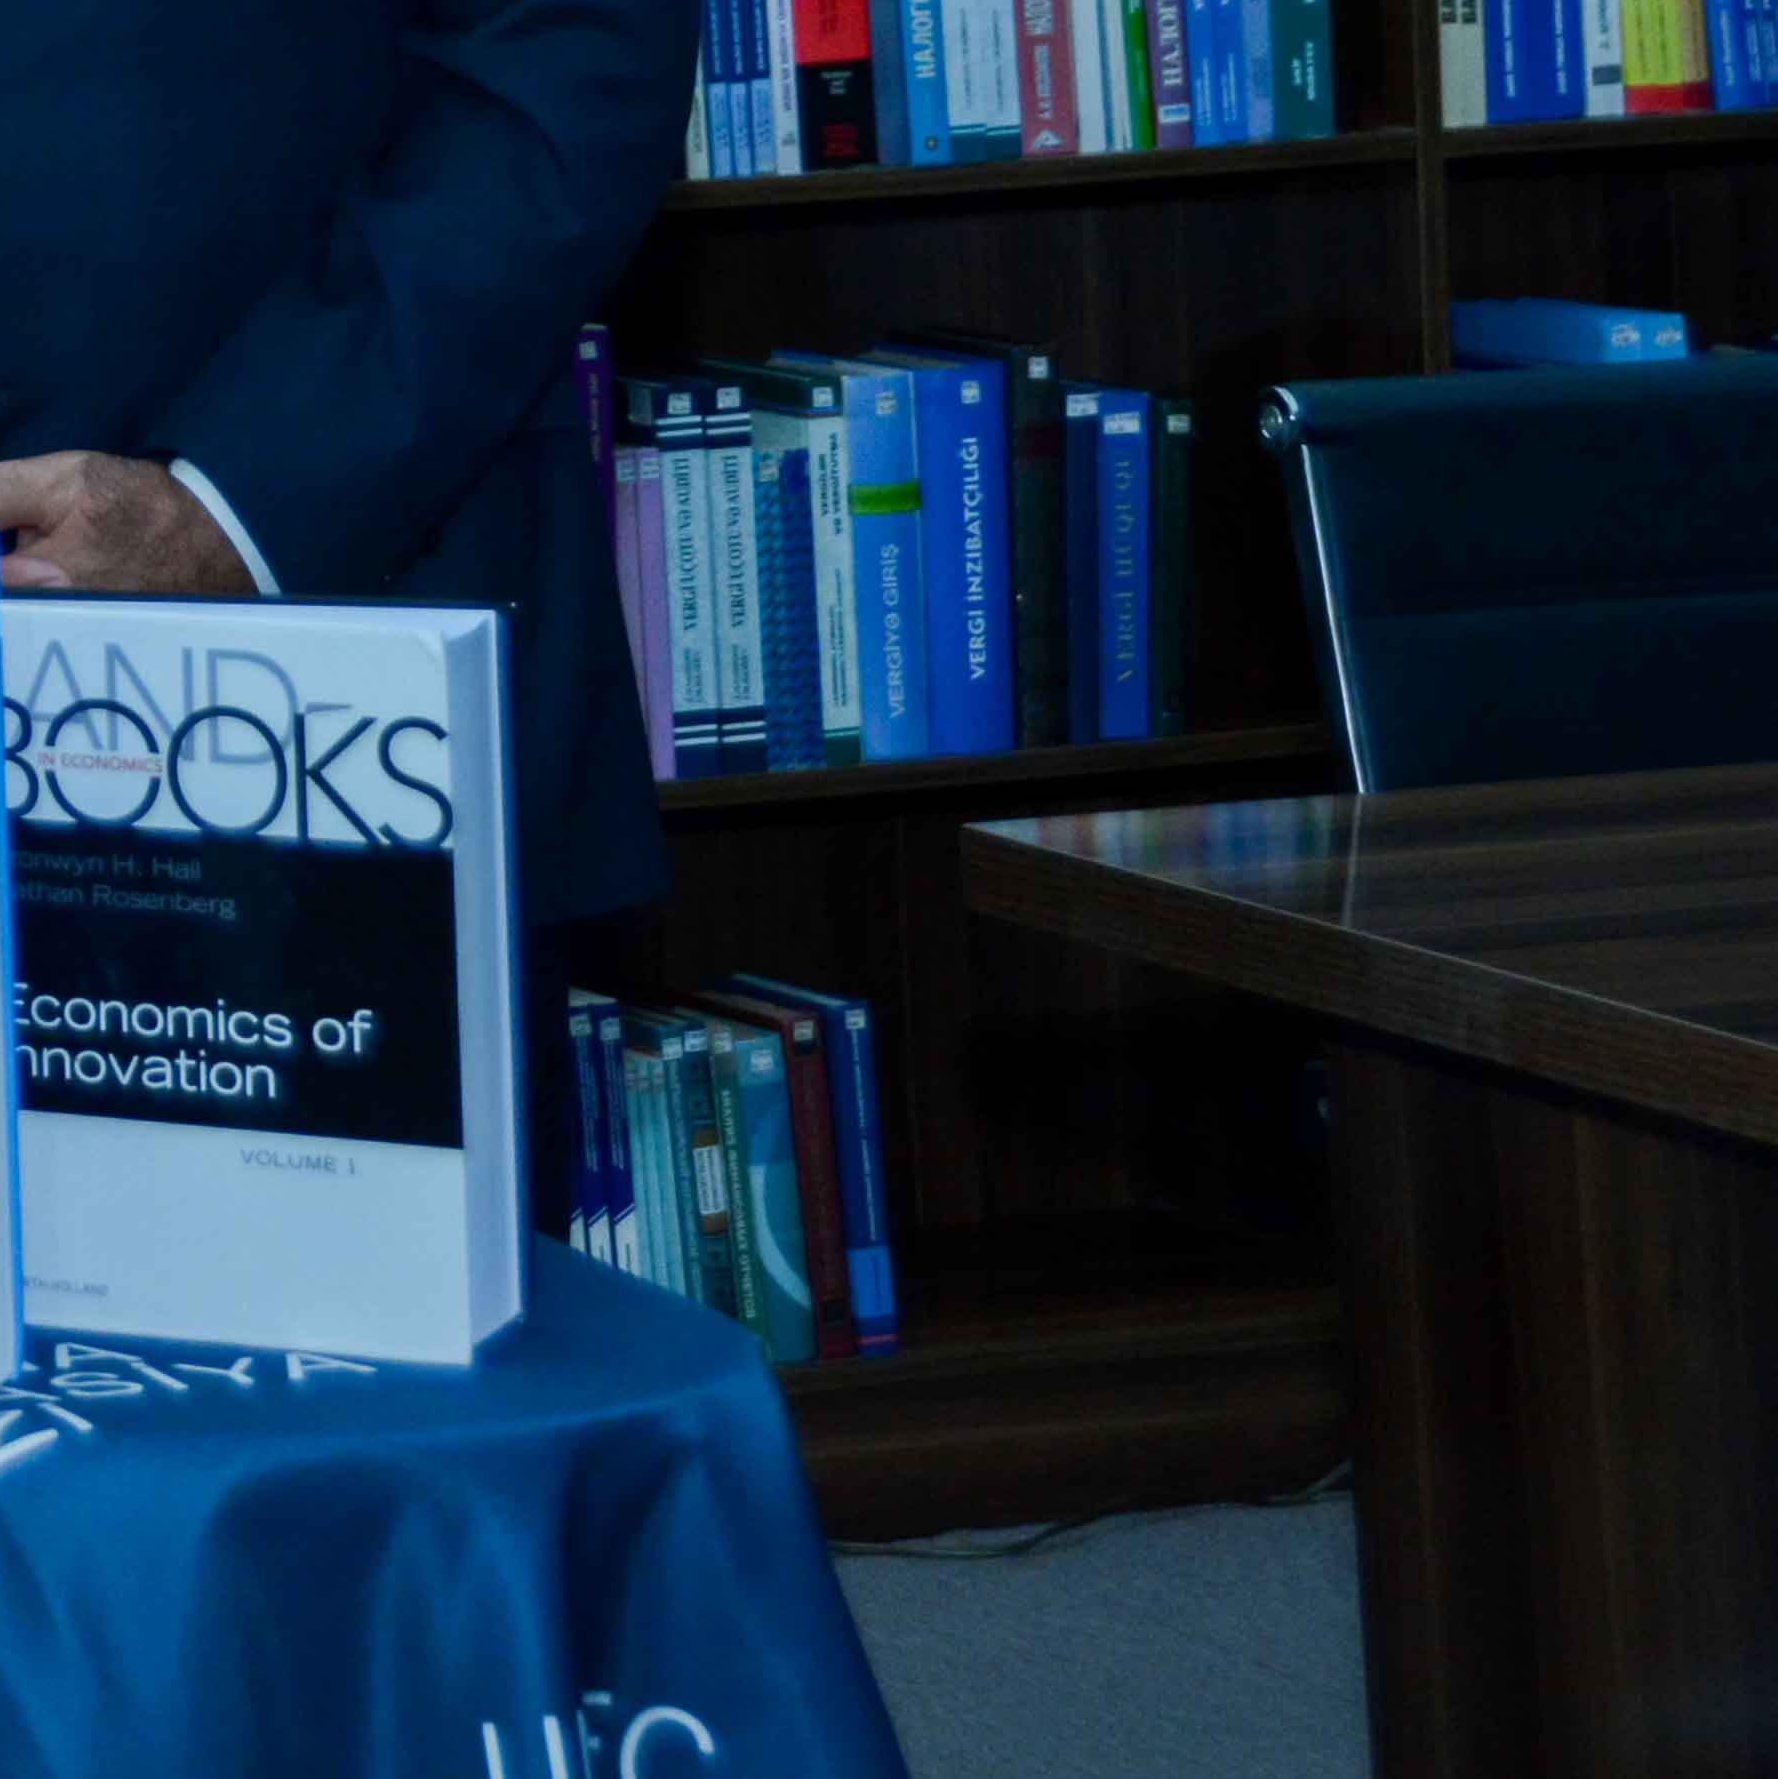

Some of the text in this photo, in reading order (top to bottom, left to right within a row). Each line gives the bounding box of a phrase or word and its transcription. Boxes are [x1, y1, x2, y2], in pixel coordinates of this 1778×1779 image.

[959, 437, 988, 680] VERGİ İNZİBATÇILIĞI
[680, 584, 699, 631] VERGİ
[728, 581, 748, 627] VERGİ
[879, 543, 905, 718] VERGİYƏ GİRİŞ
[58, 752, 165, 775] ECONOMICS
[8, 849, 202, 881] ronwyn H. Hall
[11, 882, 237, 921] athan Rosenberg
[12, 982, 374, 1054] Economics of
[13, 1042, 278, 1100] nnovation
[239, 1147, 339, 1174] VOLUME
